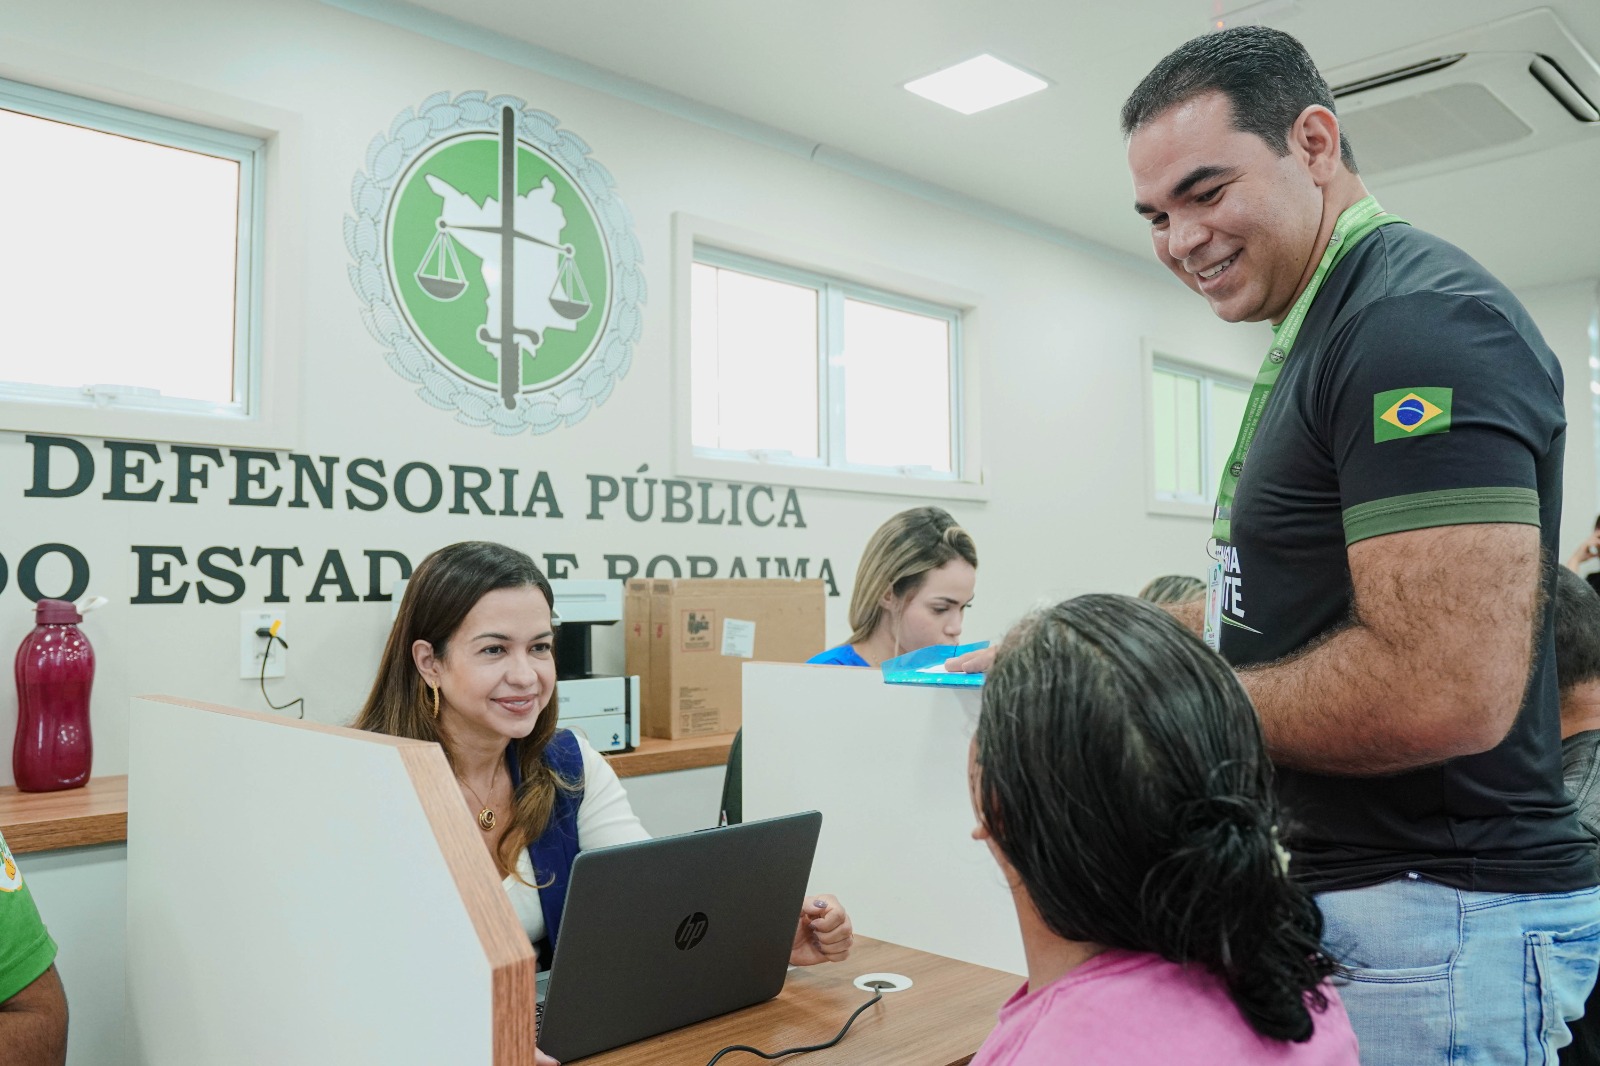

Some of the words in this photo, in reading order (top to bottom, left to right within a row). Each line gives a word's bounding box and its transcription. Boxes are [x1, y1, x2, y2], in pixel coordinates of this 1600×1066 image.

[24, 434, 563, 518] DEFENSORIA
[586, 464, 807, 528] PÚBLICA
[0, 543, 90, 603] O
[131, 546, 412, 604] ESTAD
[676, 912, 708, 950] hp
